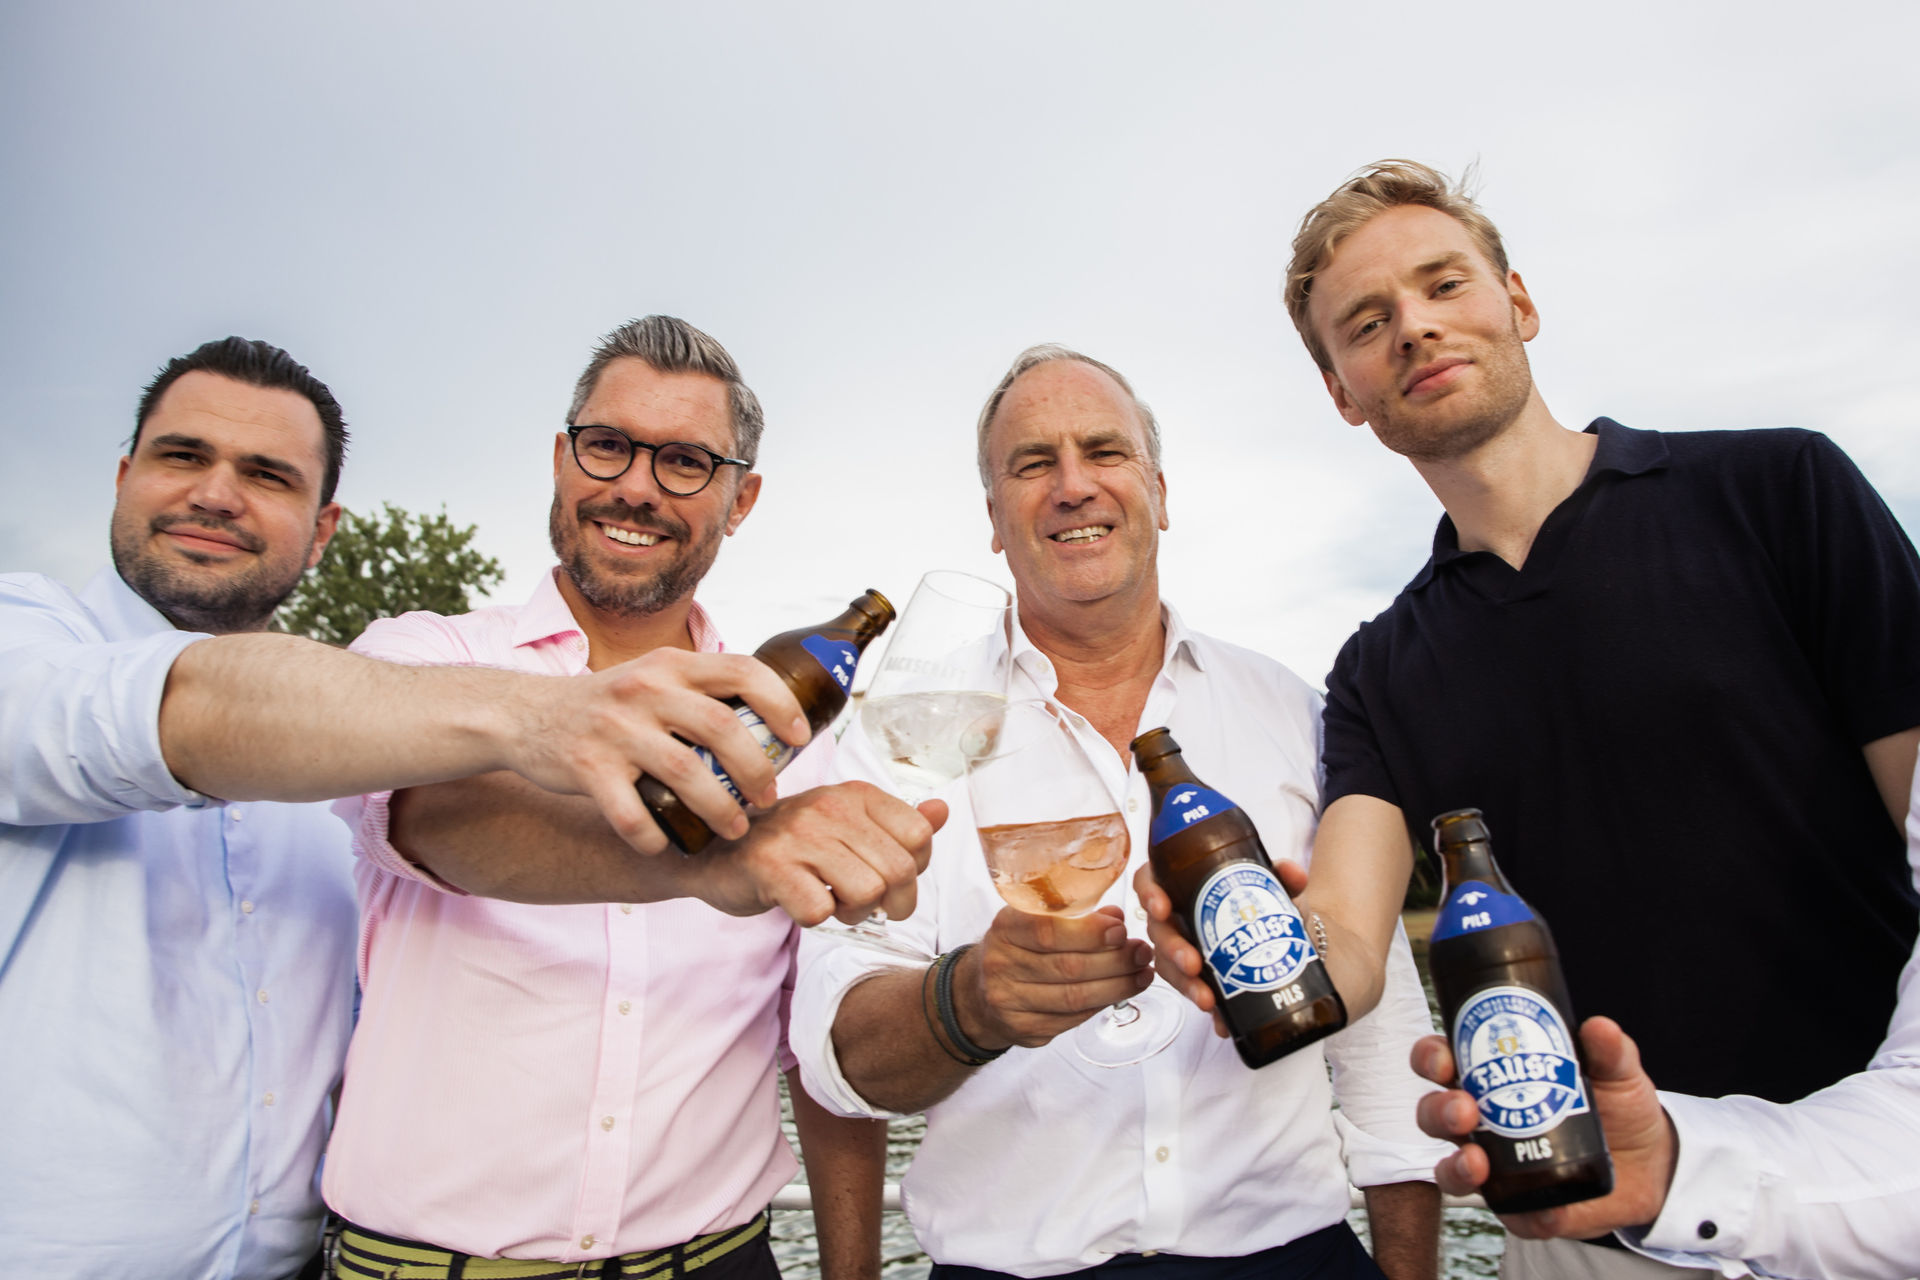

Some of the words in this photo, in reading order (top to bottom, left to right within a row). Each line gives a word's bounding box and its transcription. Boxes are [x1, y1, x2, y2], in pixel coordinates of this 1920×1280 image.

[832, 664, 850, 687] PILS
[1182, 805, 1210, 824] PILS
[1461, 911, 1492, 930] PILS
[1219, 914, 1294, 962] FAUST
[1271, 983, 1305, 1010] PILS
[1471, 1054, 1564, 1094] FAUST
[1514, 1137, 1553, 1163] PILS
